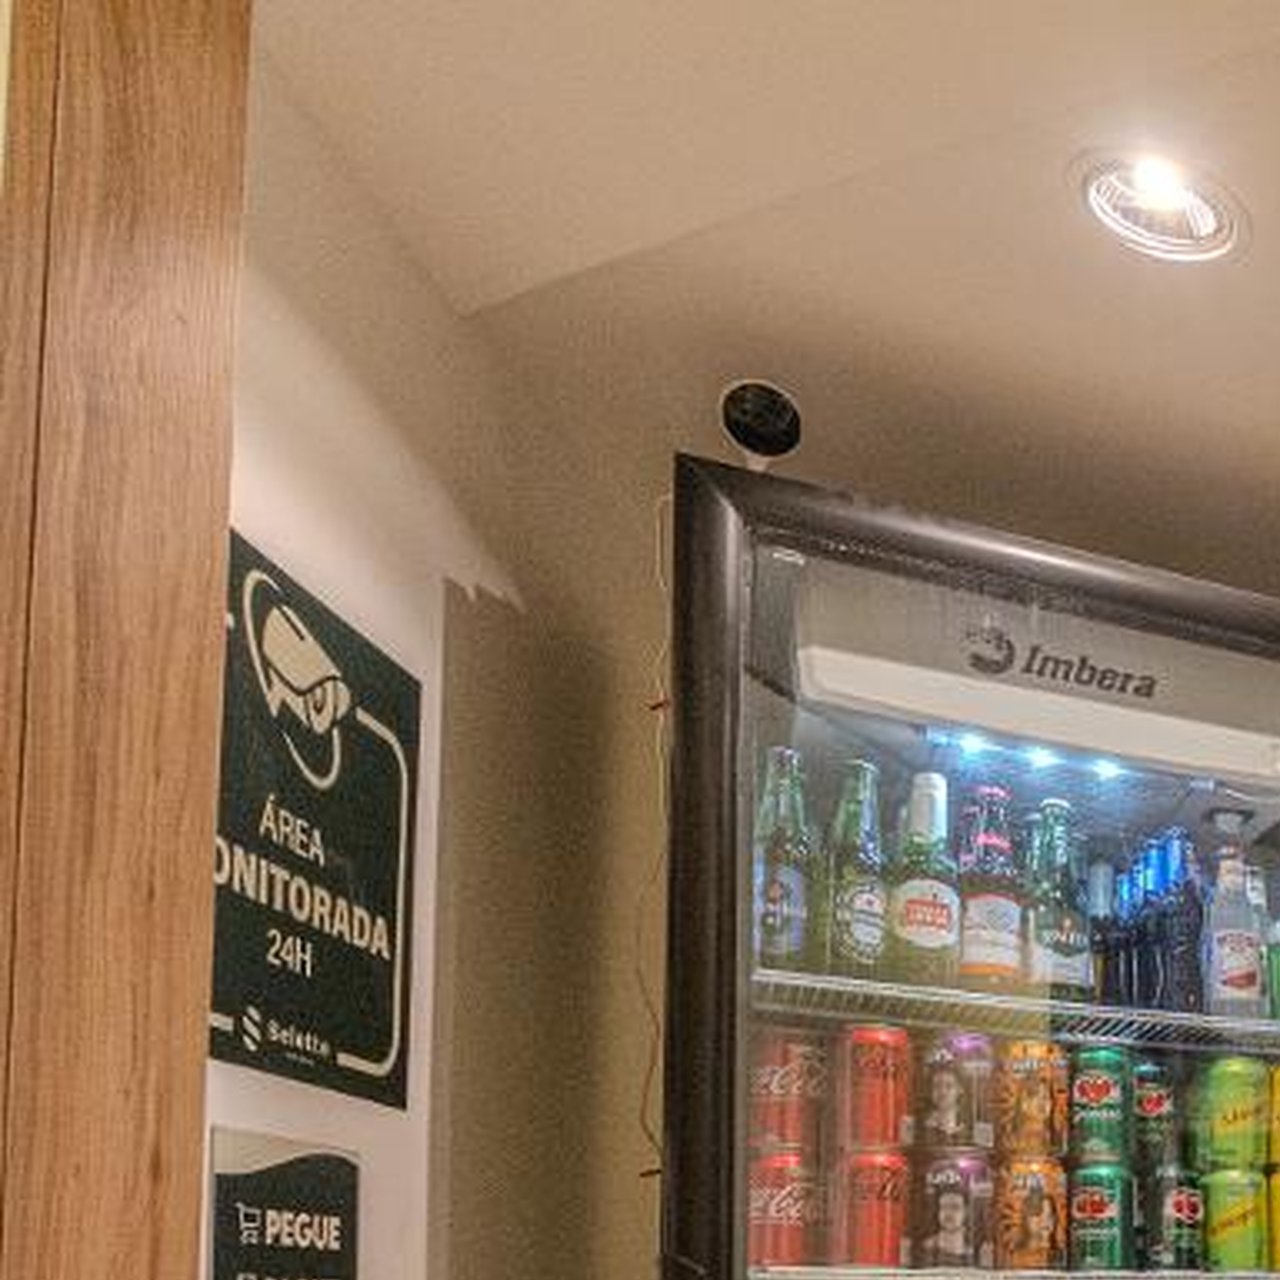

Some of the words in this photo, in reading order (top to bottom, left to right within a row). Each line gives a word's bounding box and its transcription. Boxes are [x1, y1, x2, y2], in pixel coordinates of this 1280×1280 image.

[1021, 644, 1157, 699] Imbera
[259, 793, 325, 868] ÁREA
[266, 928, 314, 978] 24H
[264, 1208, 343, 1251] PEGUE
